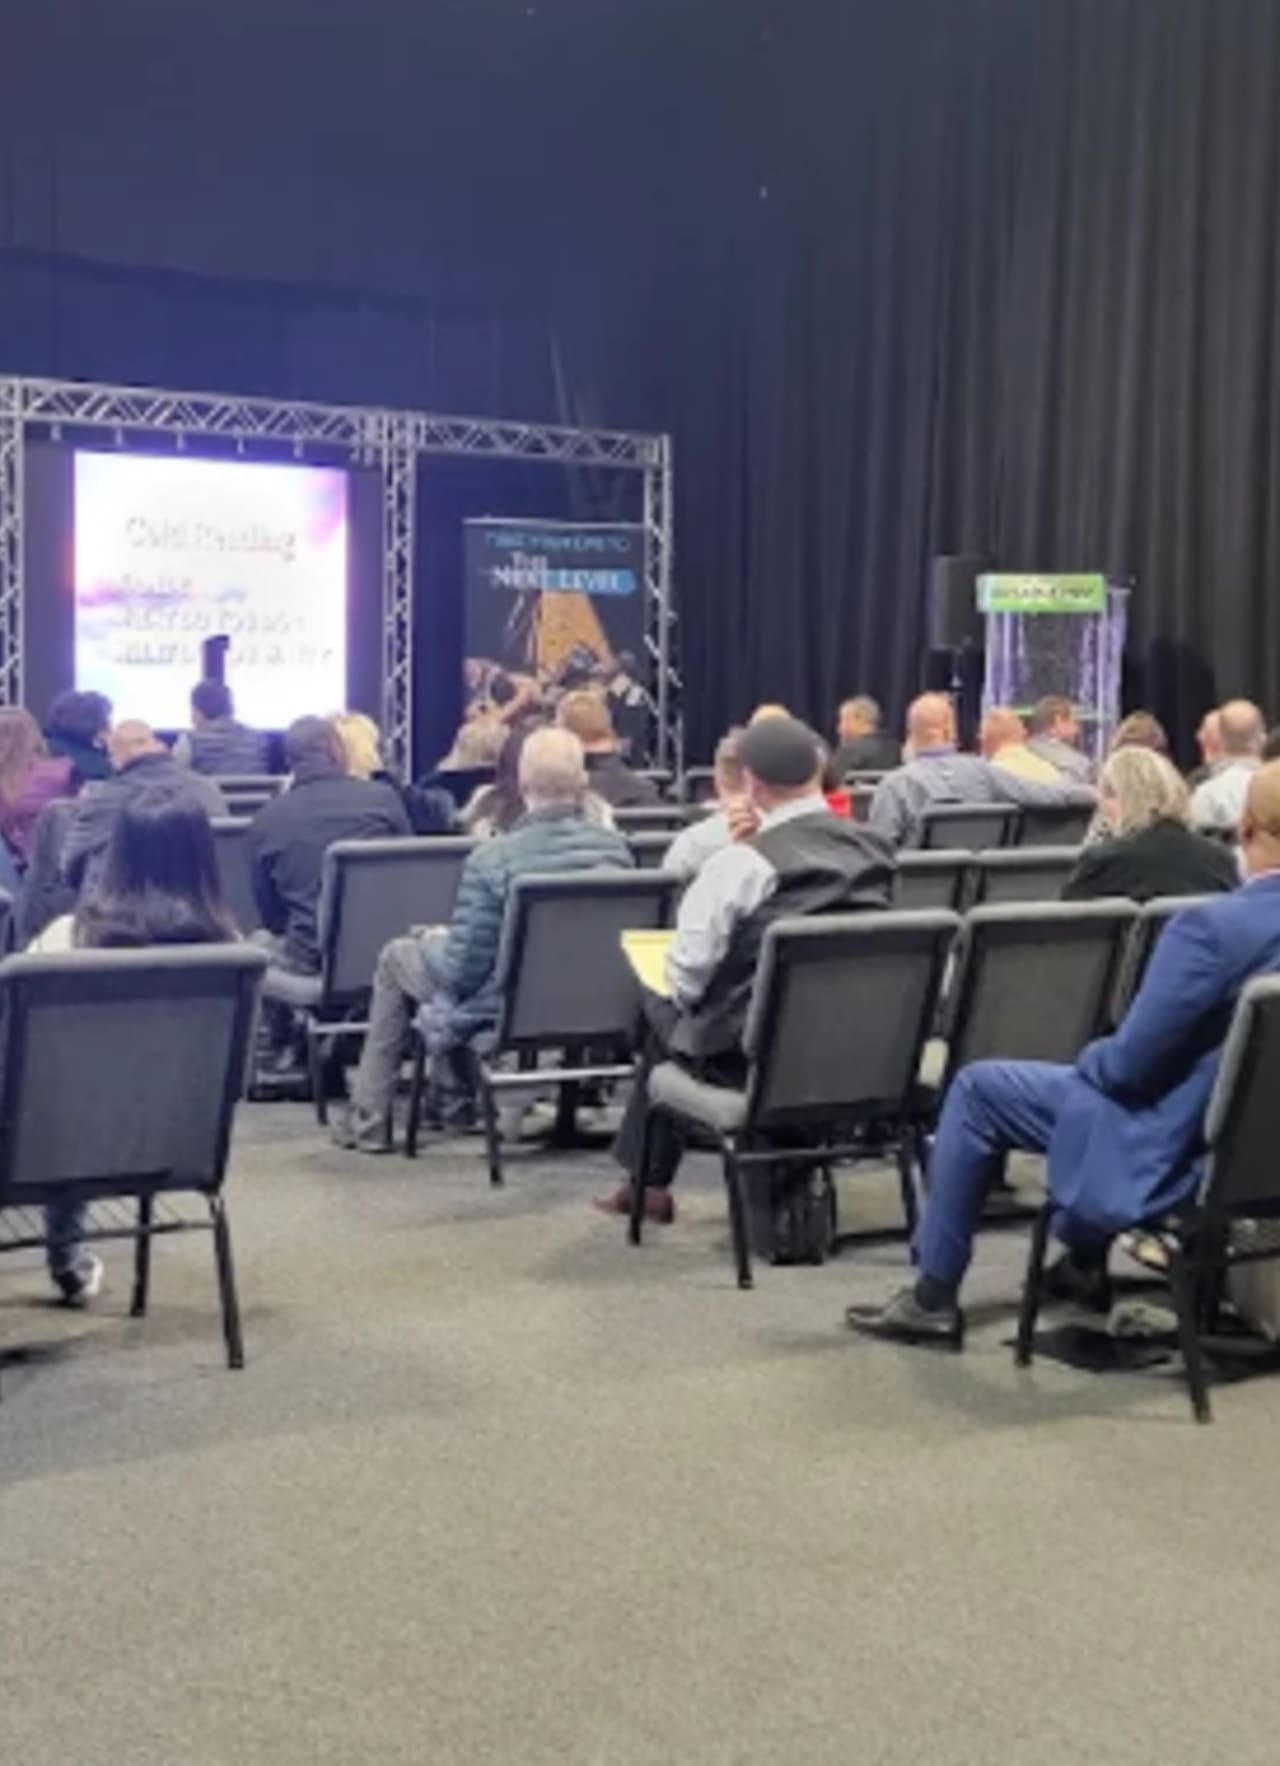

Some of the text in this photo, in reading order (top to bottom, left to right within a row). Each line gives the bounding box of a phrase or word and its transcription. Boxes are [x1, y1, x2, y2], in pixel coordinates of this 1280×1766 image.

[194, 521, 296, 563] Reading
[490, 565, 618, 591] NEXT LEVEL
